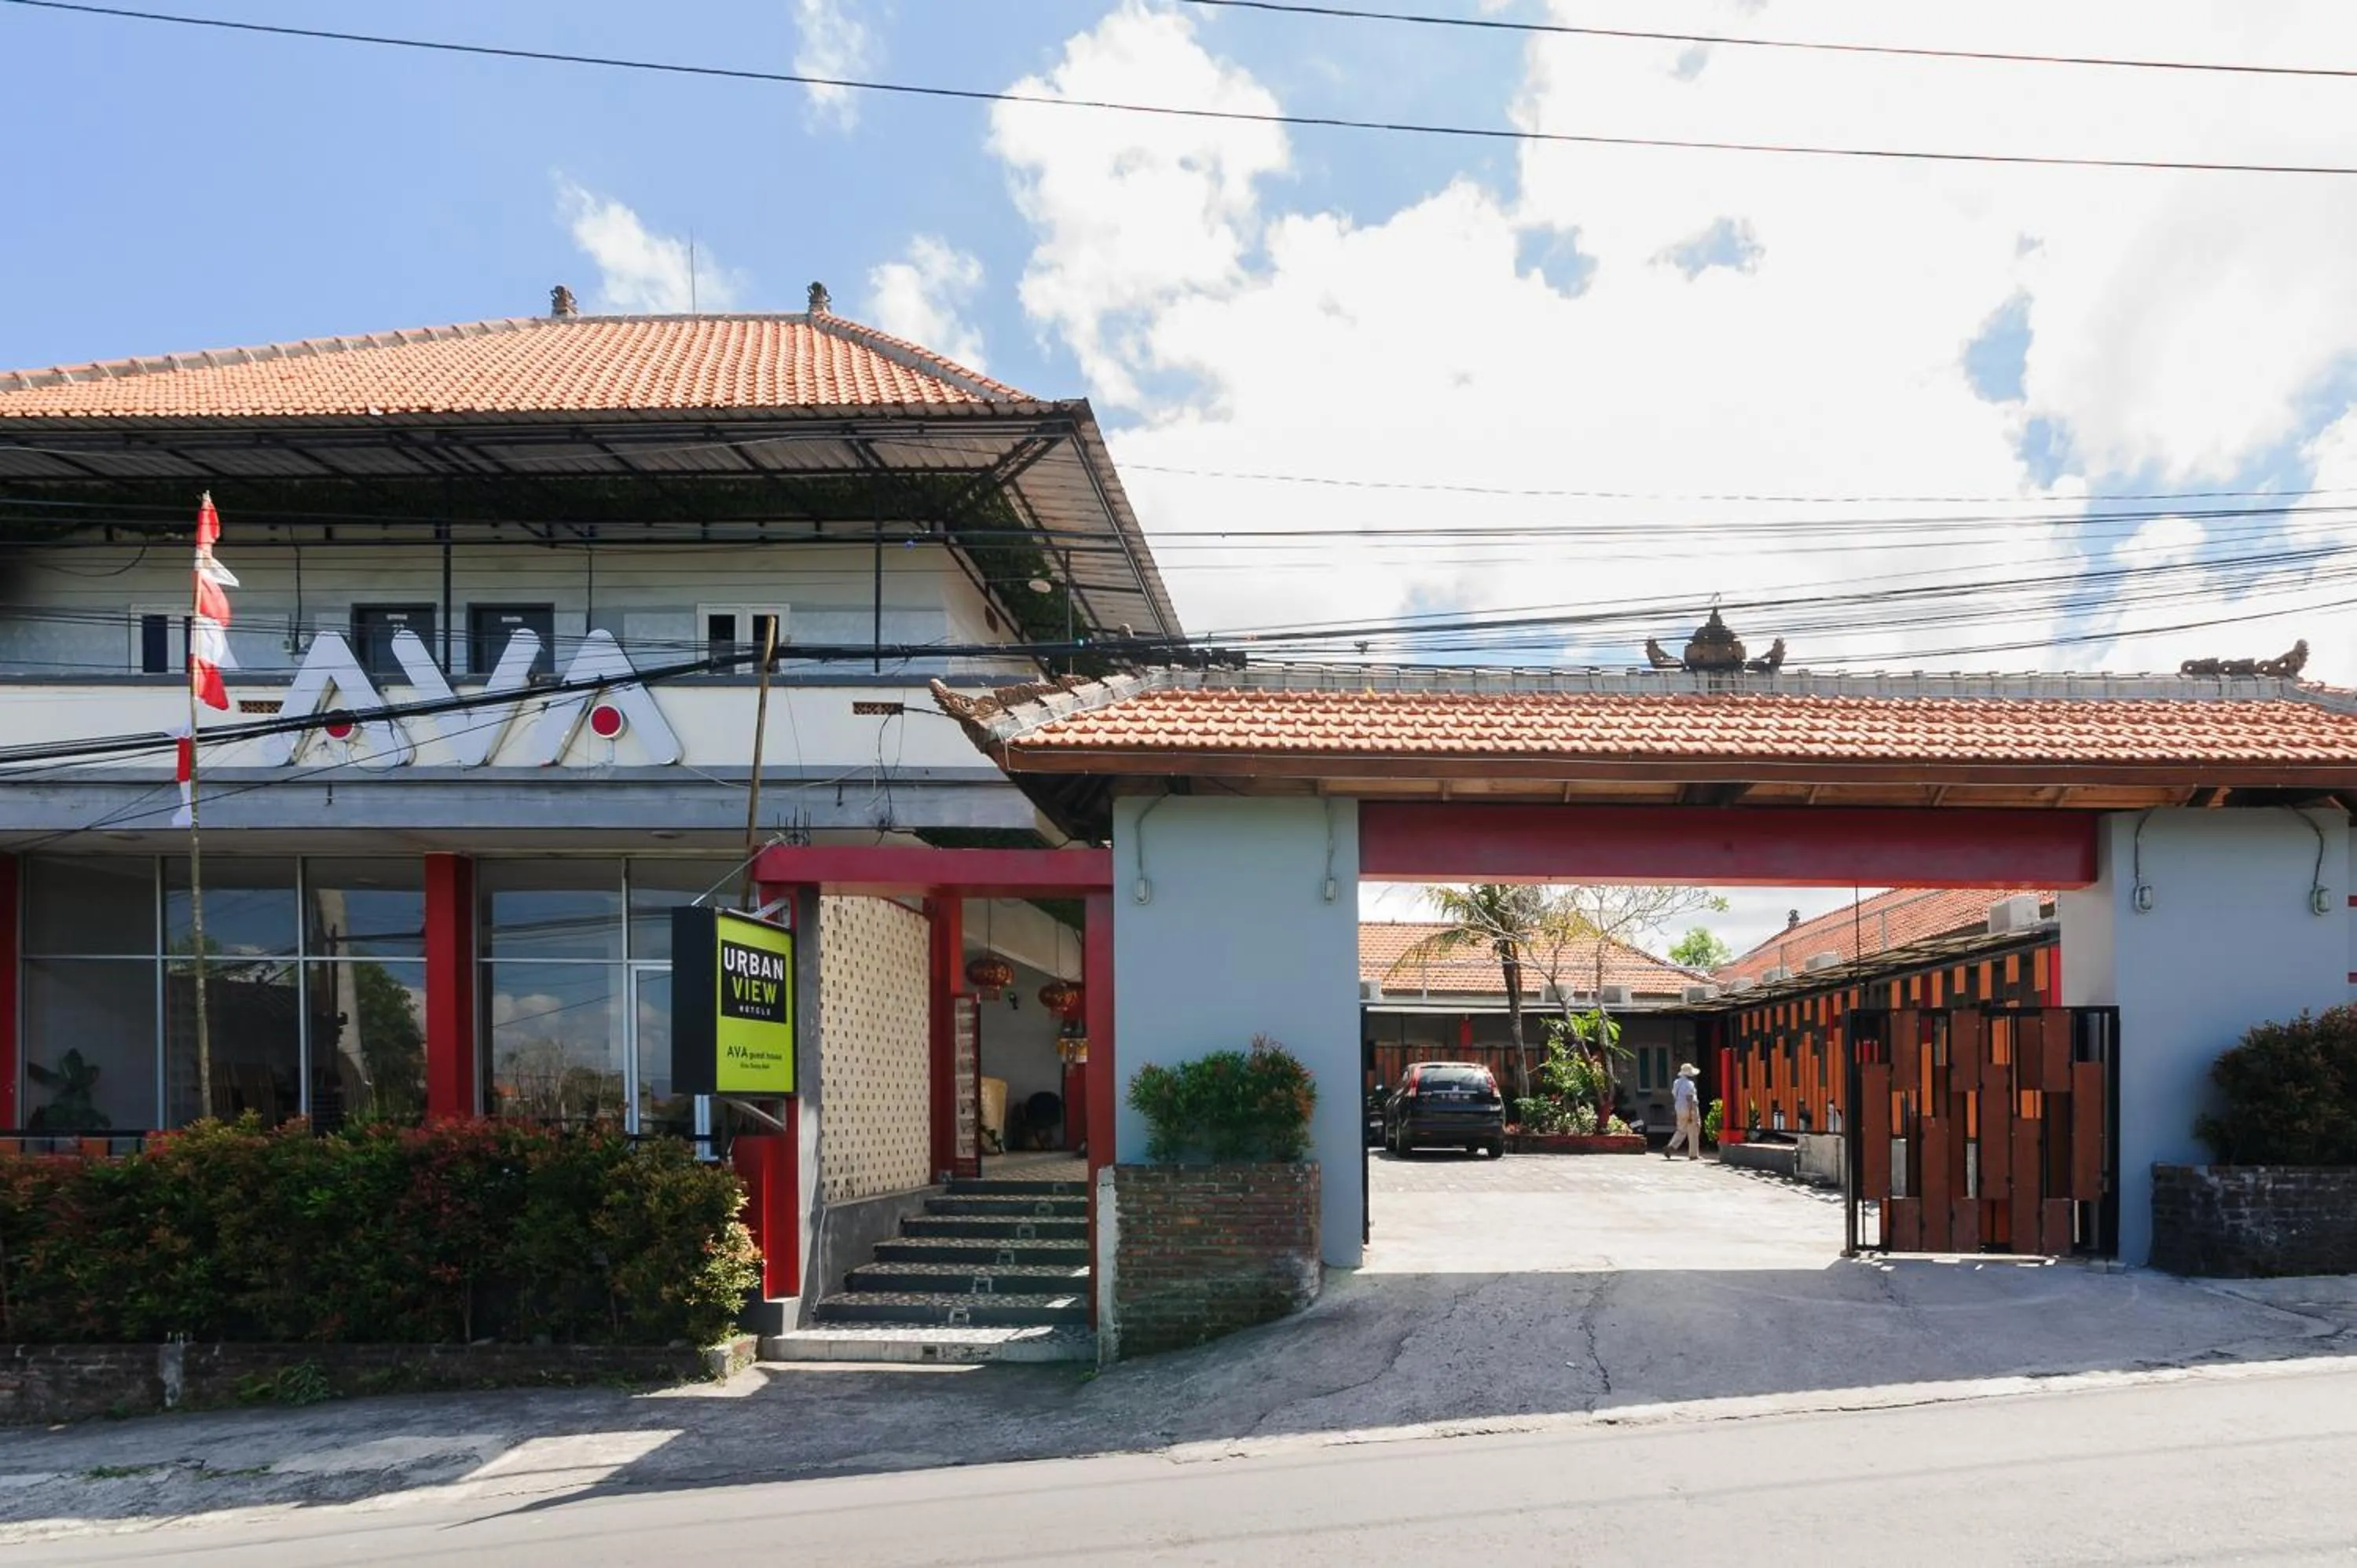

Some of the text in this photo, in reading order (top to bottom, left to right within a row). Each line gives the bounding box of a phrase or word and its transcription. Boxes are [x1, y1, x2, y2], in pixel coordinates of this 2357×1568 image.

[262, 629, 684, 767] AVA
[724, 947, 783, 980] URBAN
[732, 976, 777, 1004] VIEW
[727, 1046, 748, 1058] AVA
